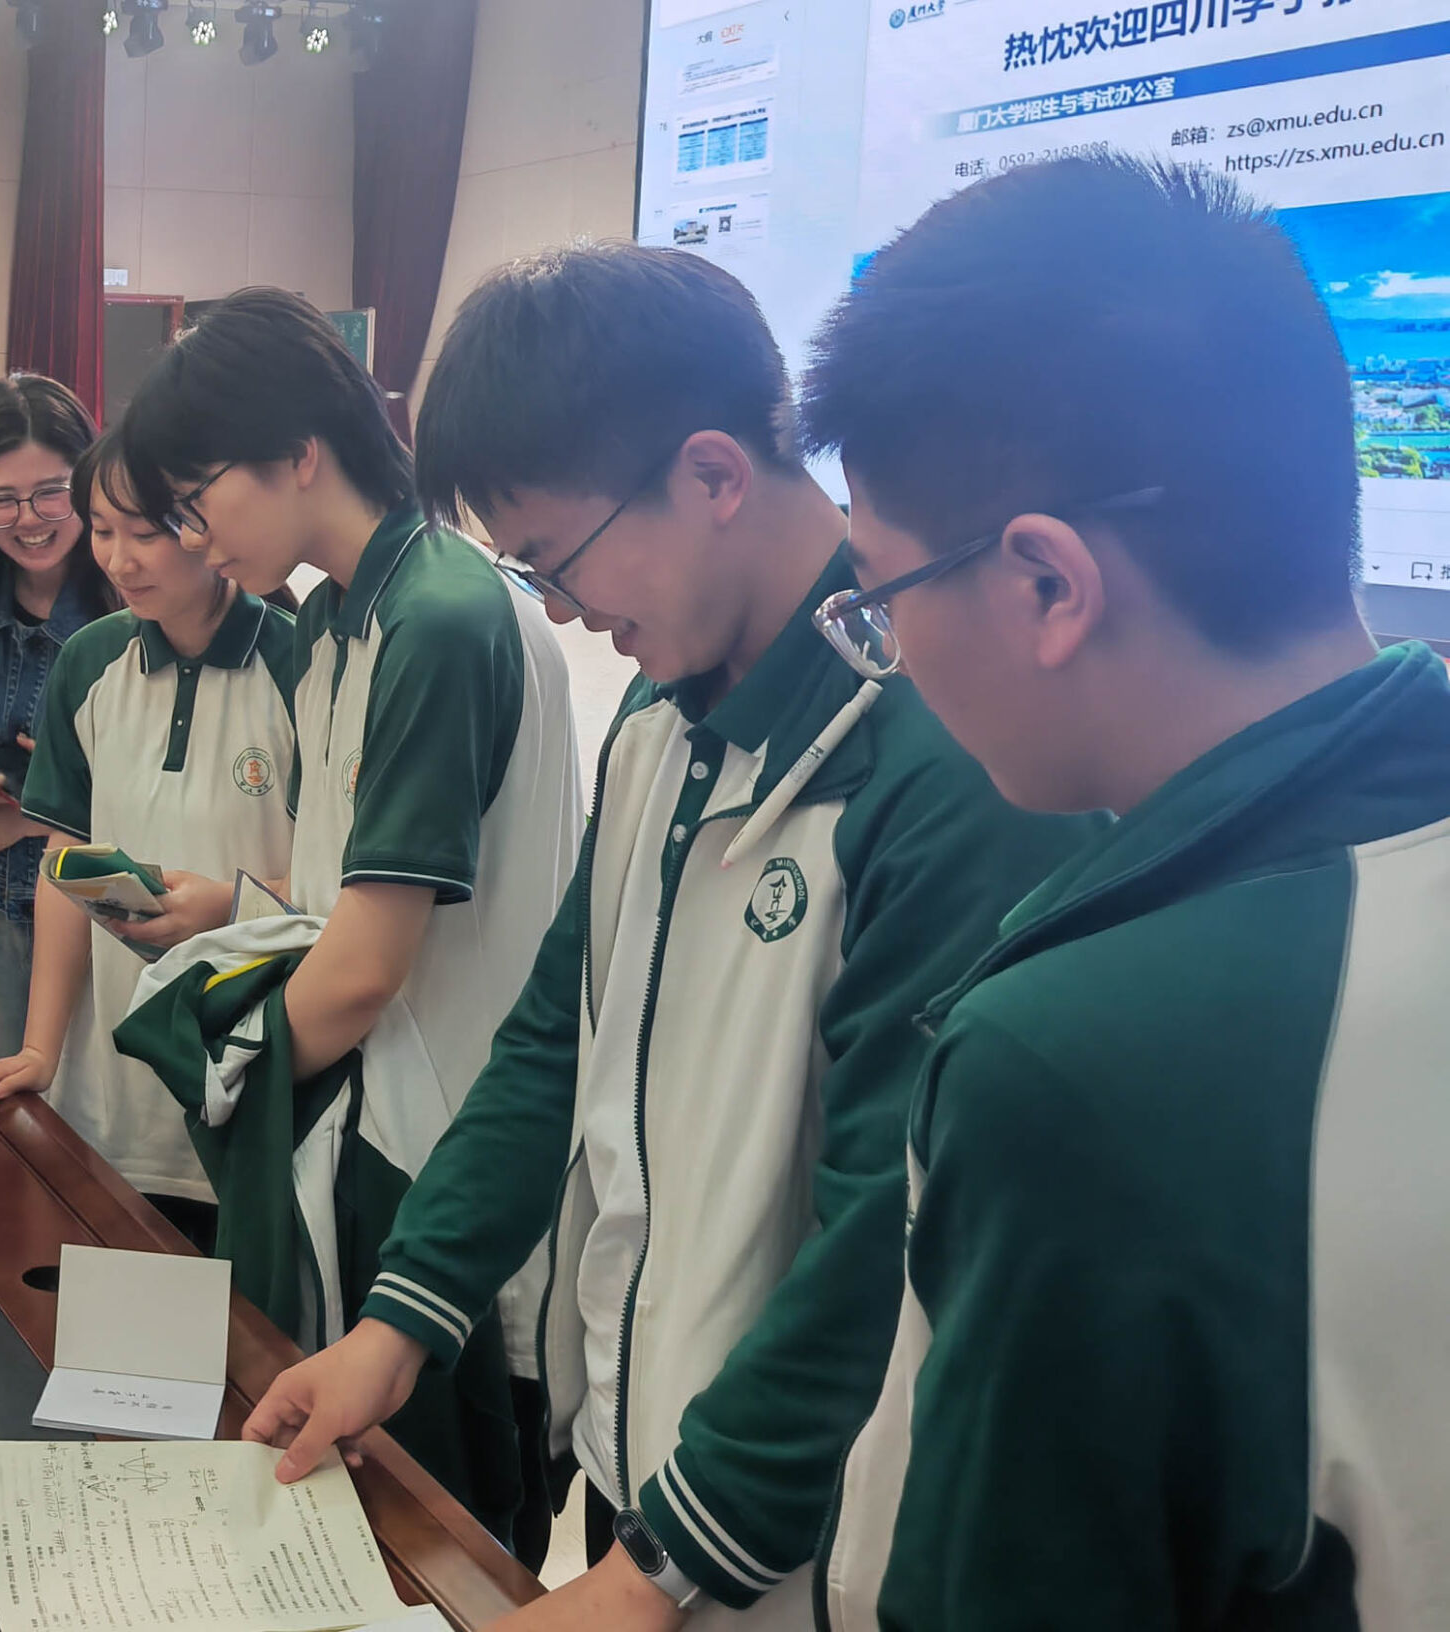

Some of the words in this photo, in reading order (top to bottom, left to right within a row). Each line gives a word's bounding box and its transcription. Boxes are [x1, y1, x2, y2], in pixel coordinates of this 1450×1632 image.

[957, 76, 1175, 133] 厦门大学招生与考试办公室
[1227, 102, 1383, 138] zs@xmu.edu.cn
[1225, 131, 1444, 174] https://zs.xmu.edu.cn
